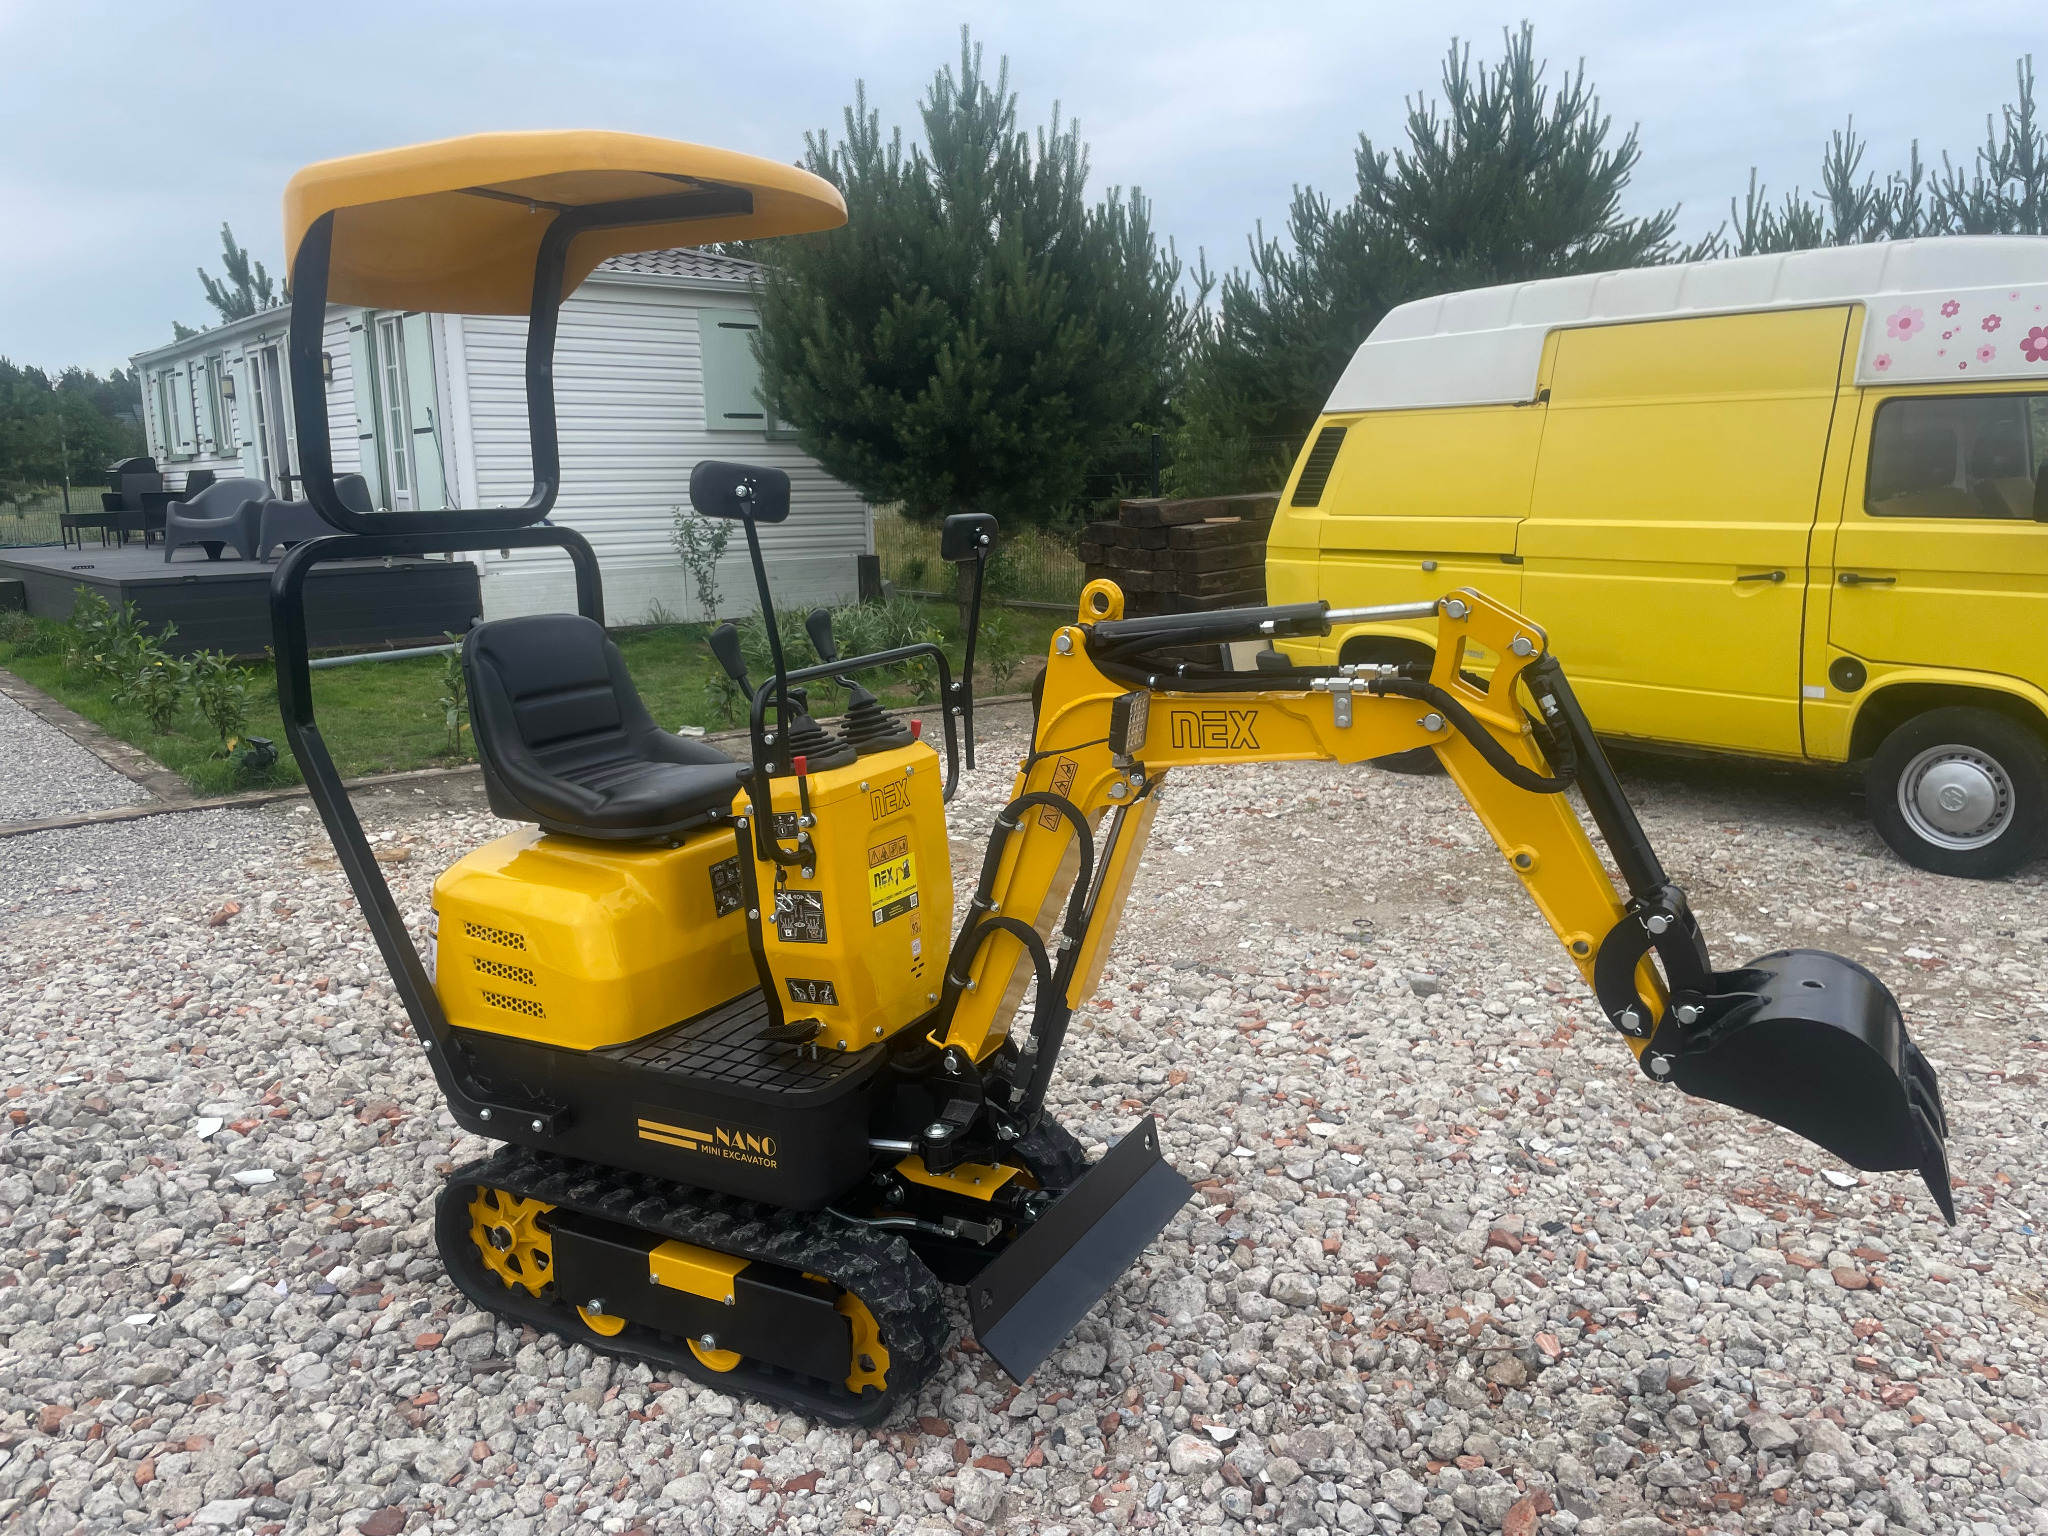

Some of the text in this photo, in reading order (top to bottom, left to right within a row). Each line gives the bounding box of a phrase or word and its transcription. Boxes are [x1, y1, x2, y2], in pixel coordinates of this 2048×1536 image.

[715, 1126, 777, 1156] NANO
[701, 1144, 777, 1169] MINI EXCAVATOR
